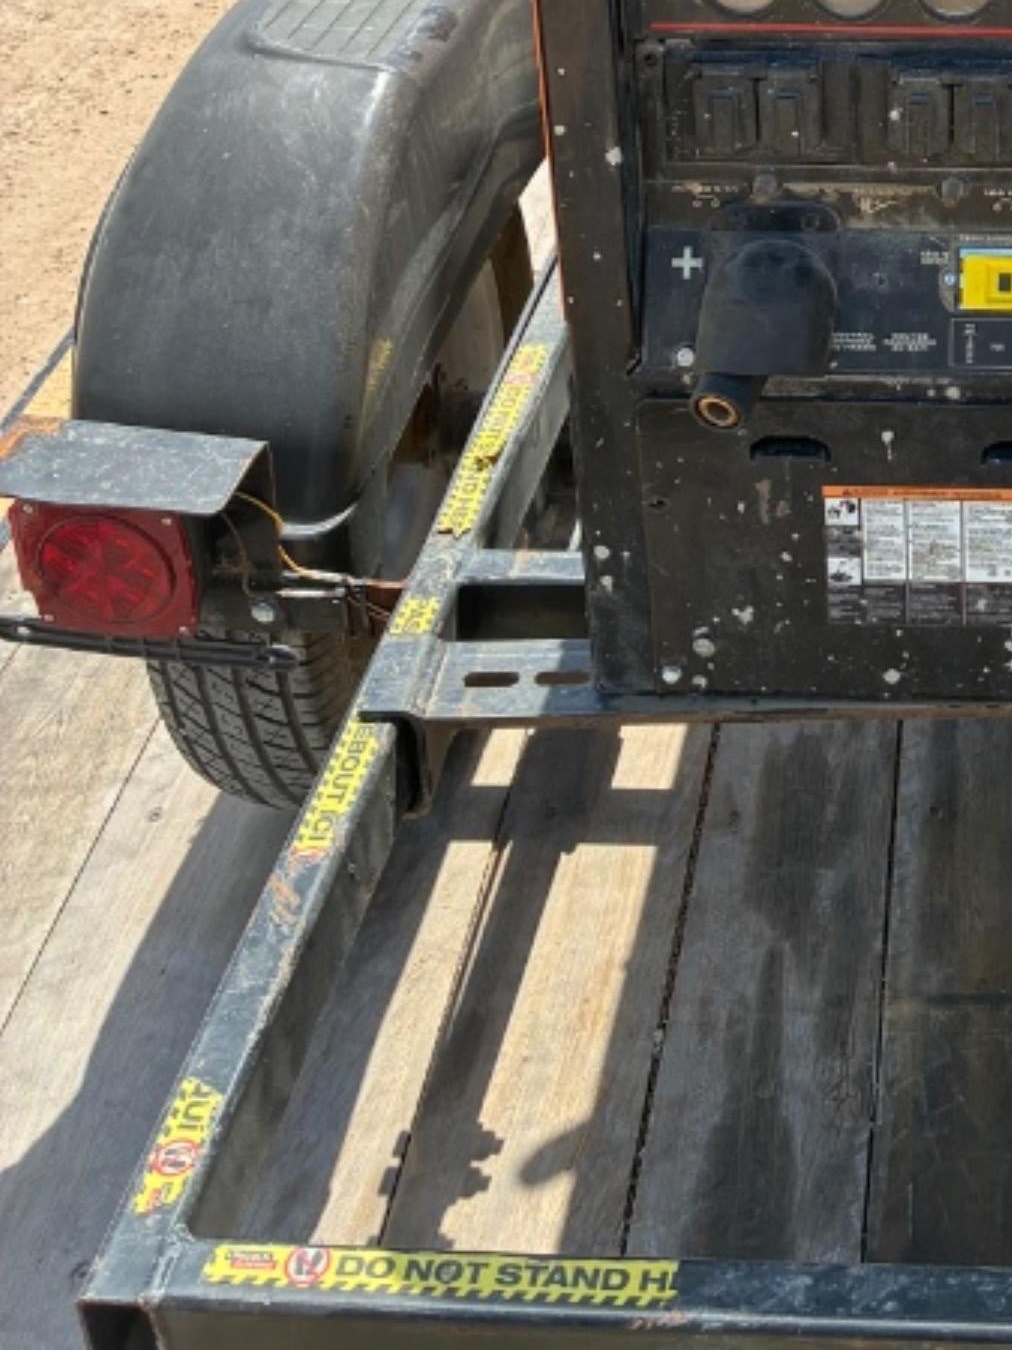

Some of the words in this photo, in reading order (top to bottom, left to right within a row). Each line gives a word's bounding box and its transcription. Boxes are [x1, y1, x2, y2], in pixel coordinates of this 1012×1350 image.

[324, 725, 374, 803] EBOUT
[334, 1255, 396, 1279] DO
[403, 1257, 490, 1285] NOT
[495, 1262, 630, 1293] STAND
